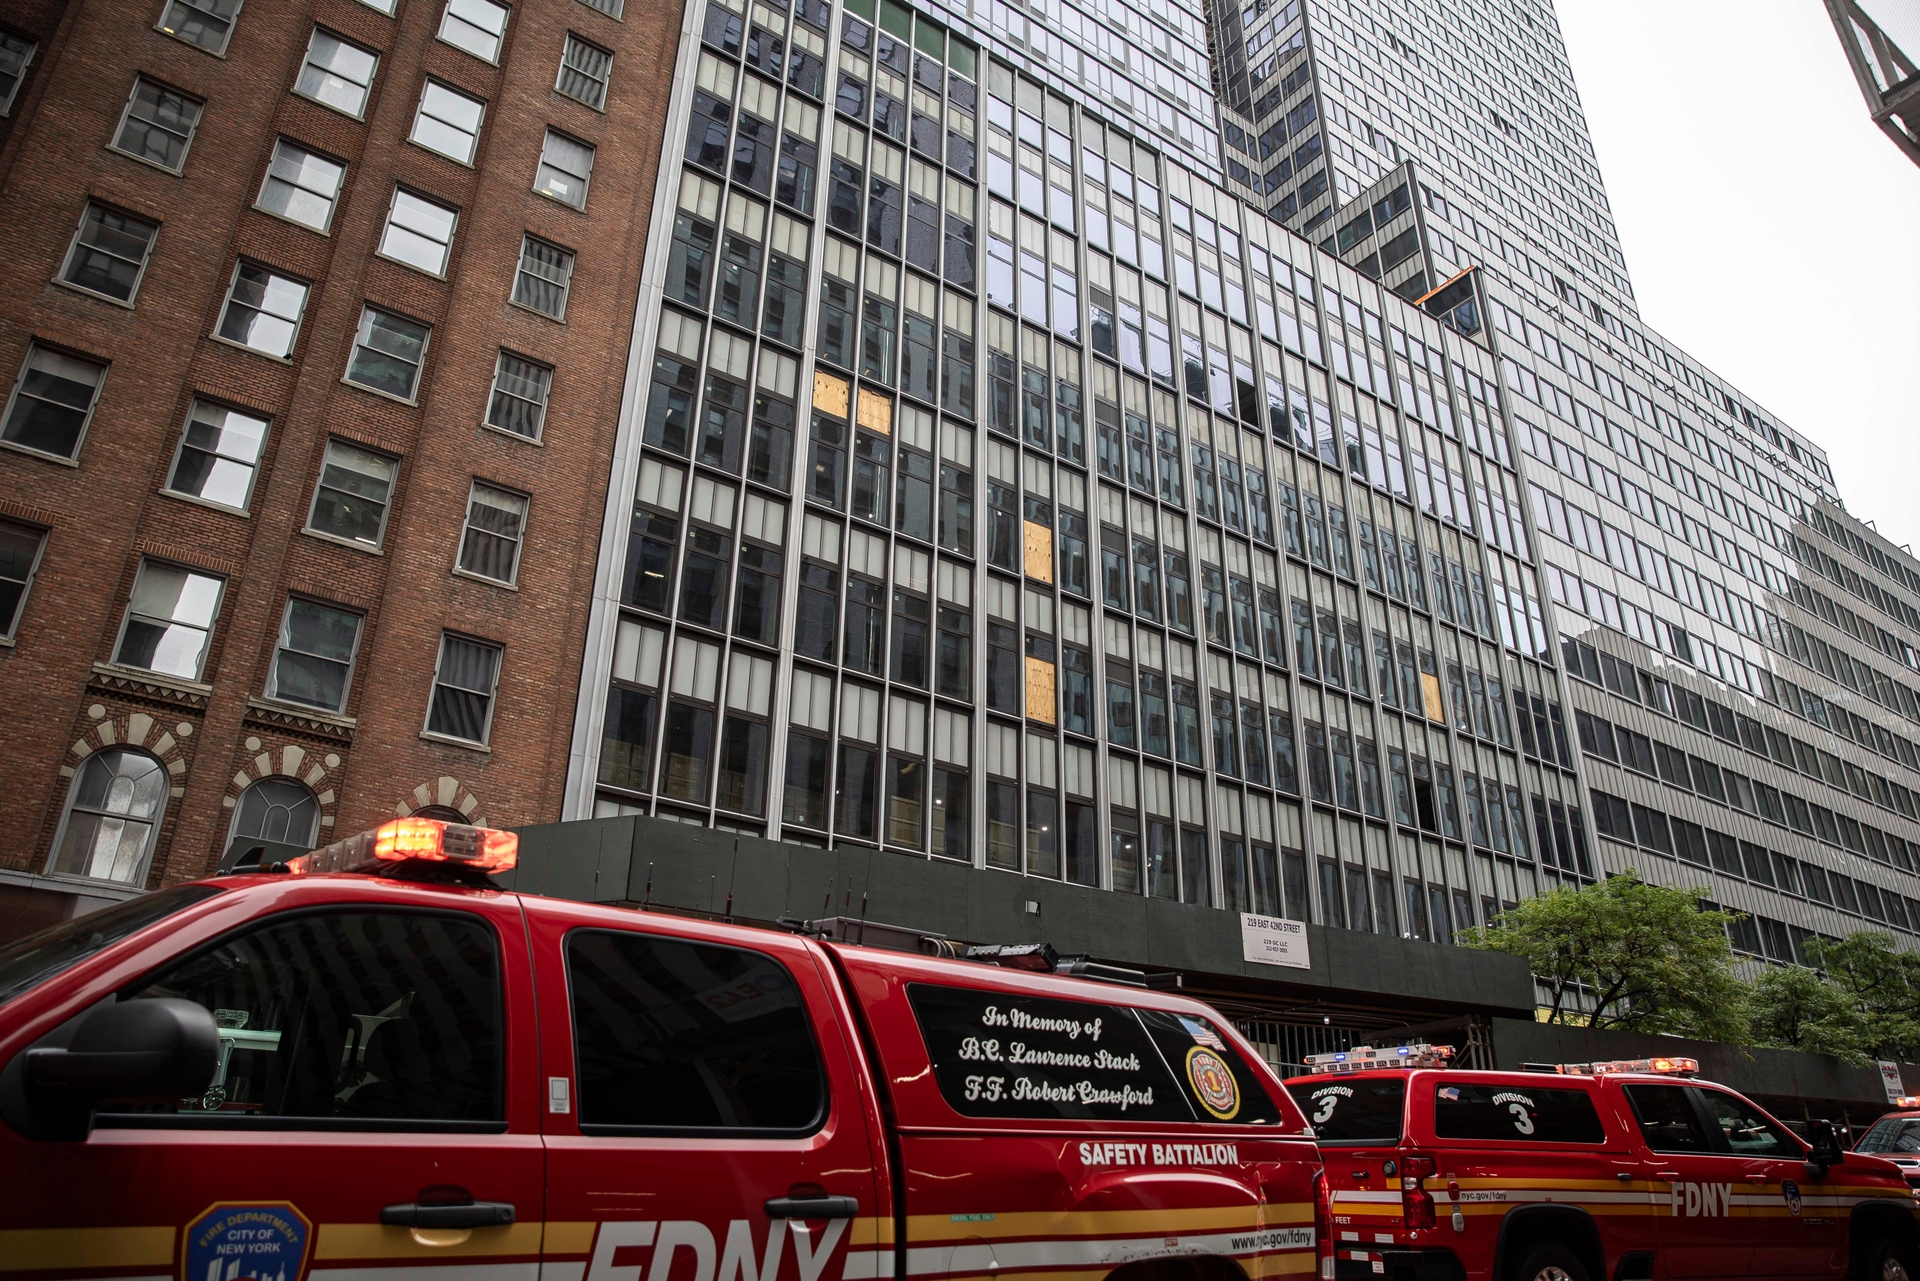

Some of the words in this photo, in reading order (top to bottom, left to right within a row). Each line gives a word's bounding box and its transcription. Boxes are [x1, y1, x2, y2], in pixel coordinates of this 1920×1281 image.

[1247, 917, 1256, 927] 219
[1258, 919, 1269, 929] EAST
[1270, 921, 1282, 931] 42ND
[1284, 923, 1300, 933] STREET
[982, 1006, 1009, 1027] In
[1010, 1008, 1081, 1040] Memory
[1084, 1018, 1102, 1042] of
[1008, 1042, 1092, 1068] Lawrence
[1093, 1050, 1141, 1072] Stack
[964, 1075, 1008, 1103] F.F.
[1011, 1076, 1076, 1103] Robert
[1075, 1080, 1154, 1112] Crawford
[1310, 1086, 1354, 1100] DIVISION
[1491, 1092, 1535, 1108] DIVISION
[1313, 1095, 1338, 1123] 3
[1508, 1103, 1535, 1135] 3
[1079, 1142, 1147, 1166] SAFETY
[1151, 1143, 1239, 1166] BATTALION
[1671, 1182, 1732, 1218] FDNY
[199, 1220, 227, 1248] FIRE
[226, 1212, 299, 1244] DEPARTMENT
[227, 1229, 256, 1241] CITY
[257, 1228, 275, 1240] OF
[1335, 1216, 1351, 1225] FEET
[216, 1243, 246, 1255] NEW
[247, 1242, 282, 1254] YORK
[586, 1217, 850, 1281] FDNY
